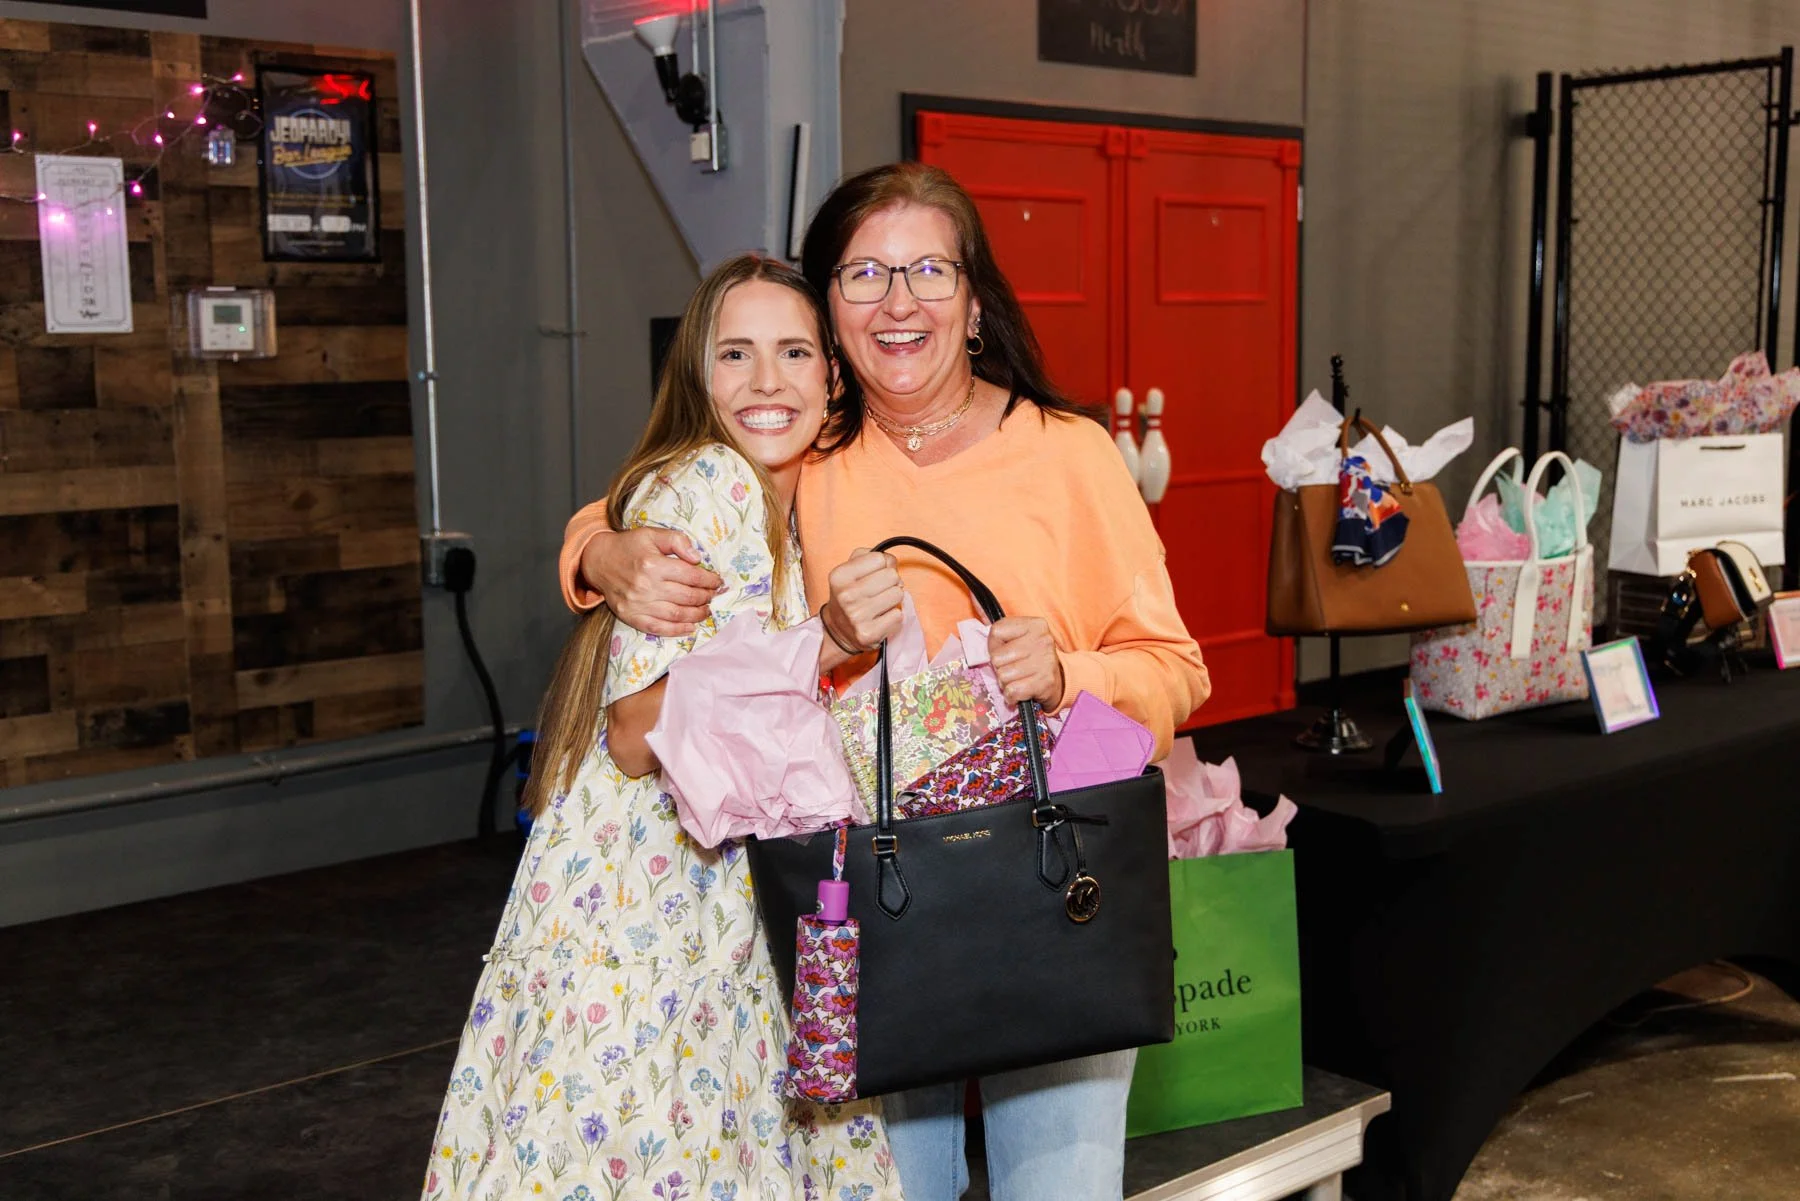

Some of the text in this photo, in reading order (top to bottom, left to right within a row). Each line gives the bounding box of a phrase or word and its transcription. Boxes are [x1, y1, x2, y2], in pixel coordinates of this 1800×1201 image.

[1680, 494, 1766, 507] MARC JACOBS
[1173, 968, 1252, 1013] pade
[1175, 1017, 1221, 1036] YORK
